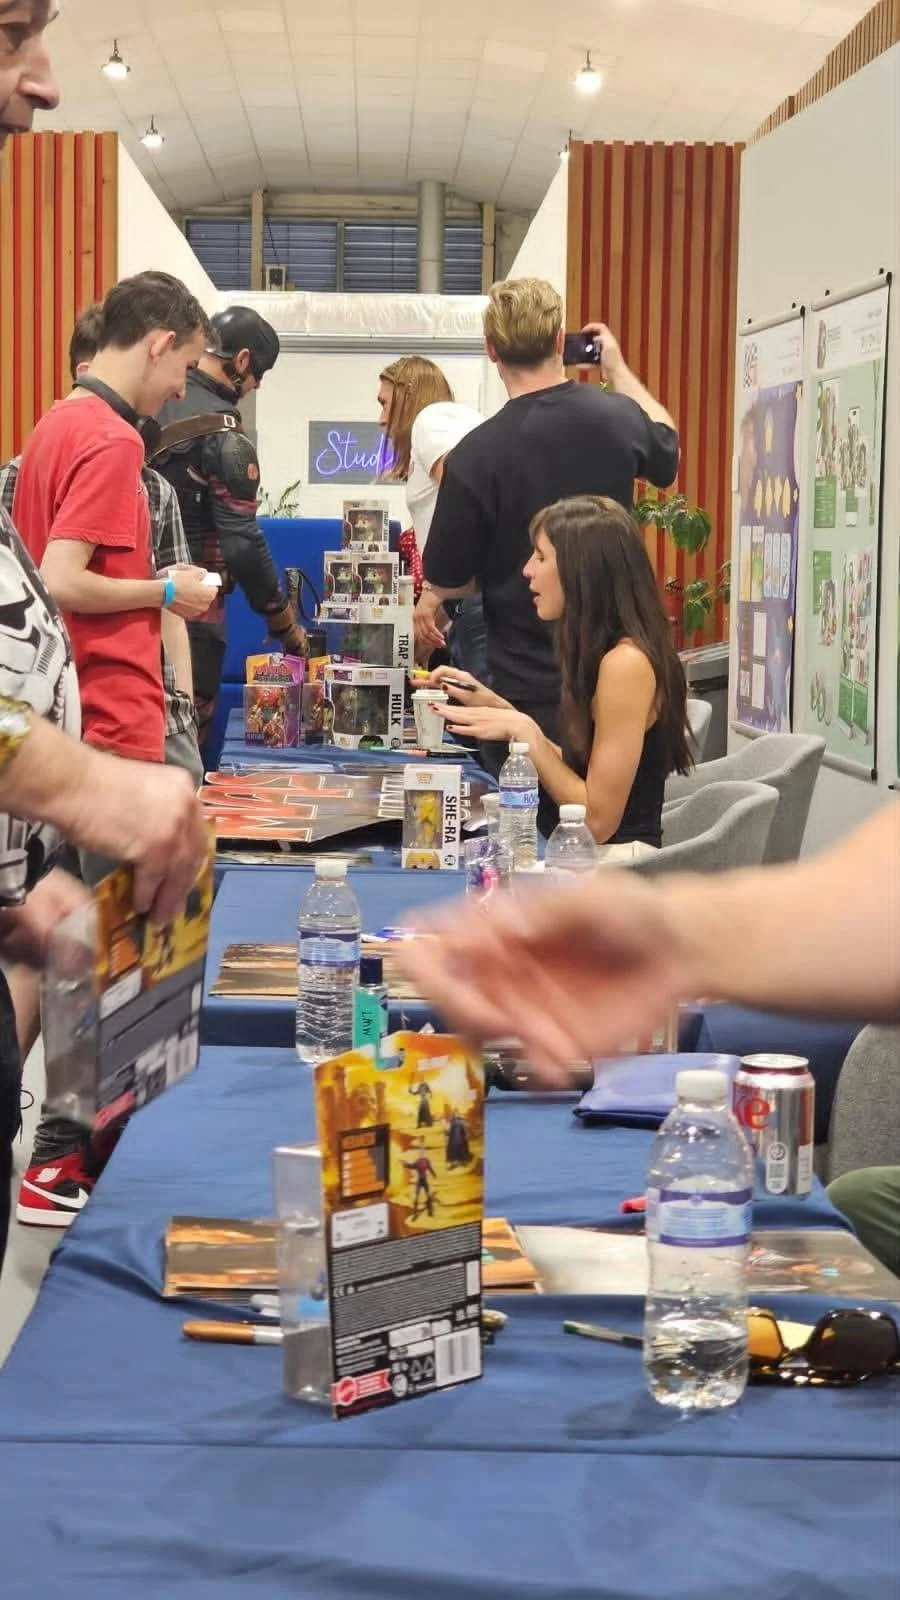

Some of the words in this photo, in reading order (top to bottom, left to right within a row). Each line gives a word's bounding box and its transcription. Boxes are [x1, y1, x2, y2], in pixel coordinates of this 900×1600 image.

[316, 430, 392, 477] Stud
[398, 633, 409, 660] TRAP
[391, 693, 402, 726] HULK
[444, 795, 457, 844] SHE-RA
